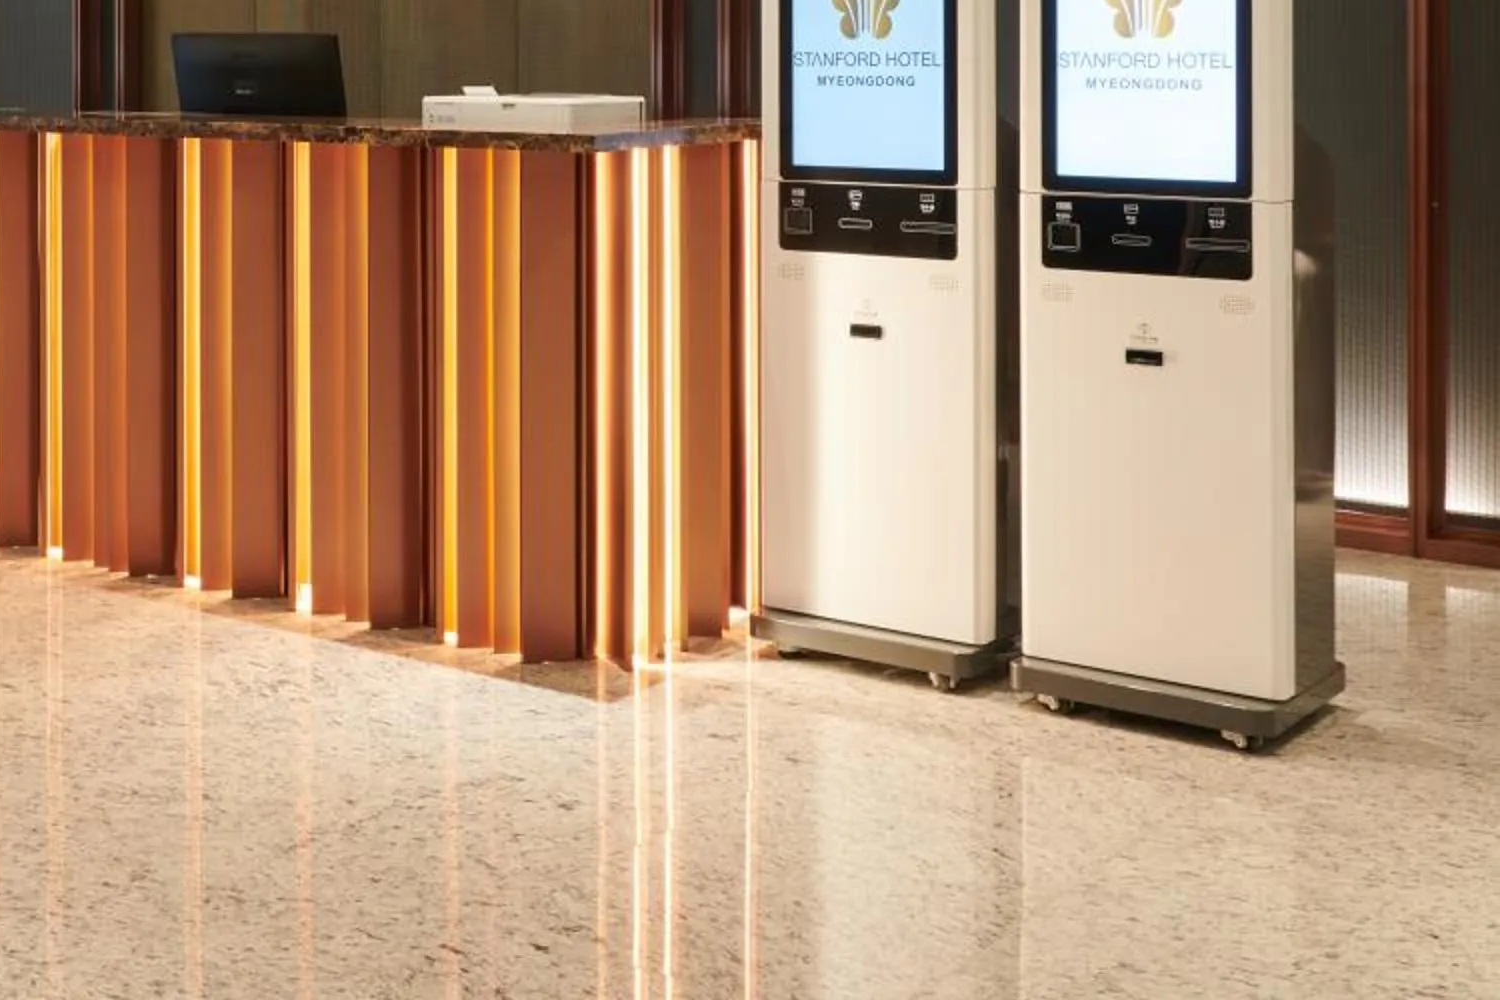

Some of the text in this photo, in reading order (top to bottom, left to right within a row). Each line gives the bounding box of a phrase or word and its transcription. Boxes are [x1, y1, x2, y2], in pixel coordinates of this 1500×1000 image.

[793, 51, 941, 67] STANFORD HOTEL
[1059, 51, 1233, 69] STANFORD HOTEL
[816, 75, 916, 87] MYEONGDONG
[1086, 77, 1203, 91] MYEONGDONG
